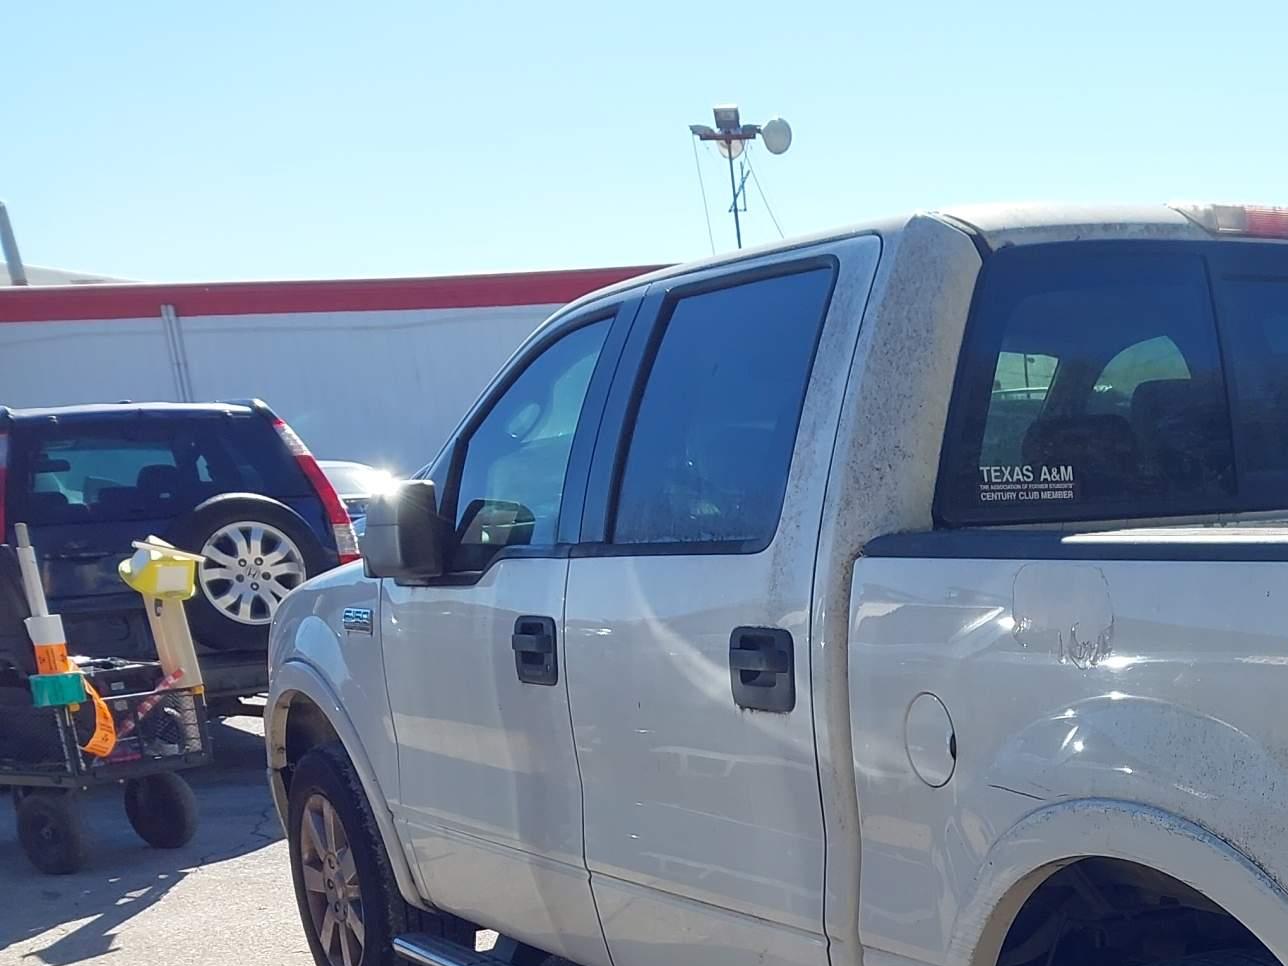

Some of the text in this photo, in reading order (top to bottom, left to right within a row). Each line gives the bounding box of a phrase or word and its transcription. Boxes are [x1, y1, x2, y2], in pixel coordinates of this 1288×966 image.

[979, 465, 1074, 482] TEXAS A&M
[981, 490, 1074, 501] CENTURY CLUB MEMBER
